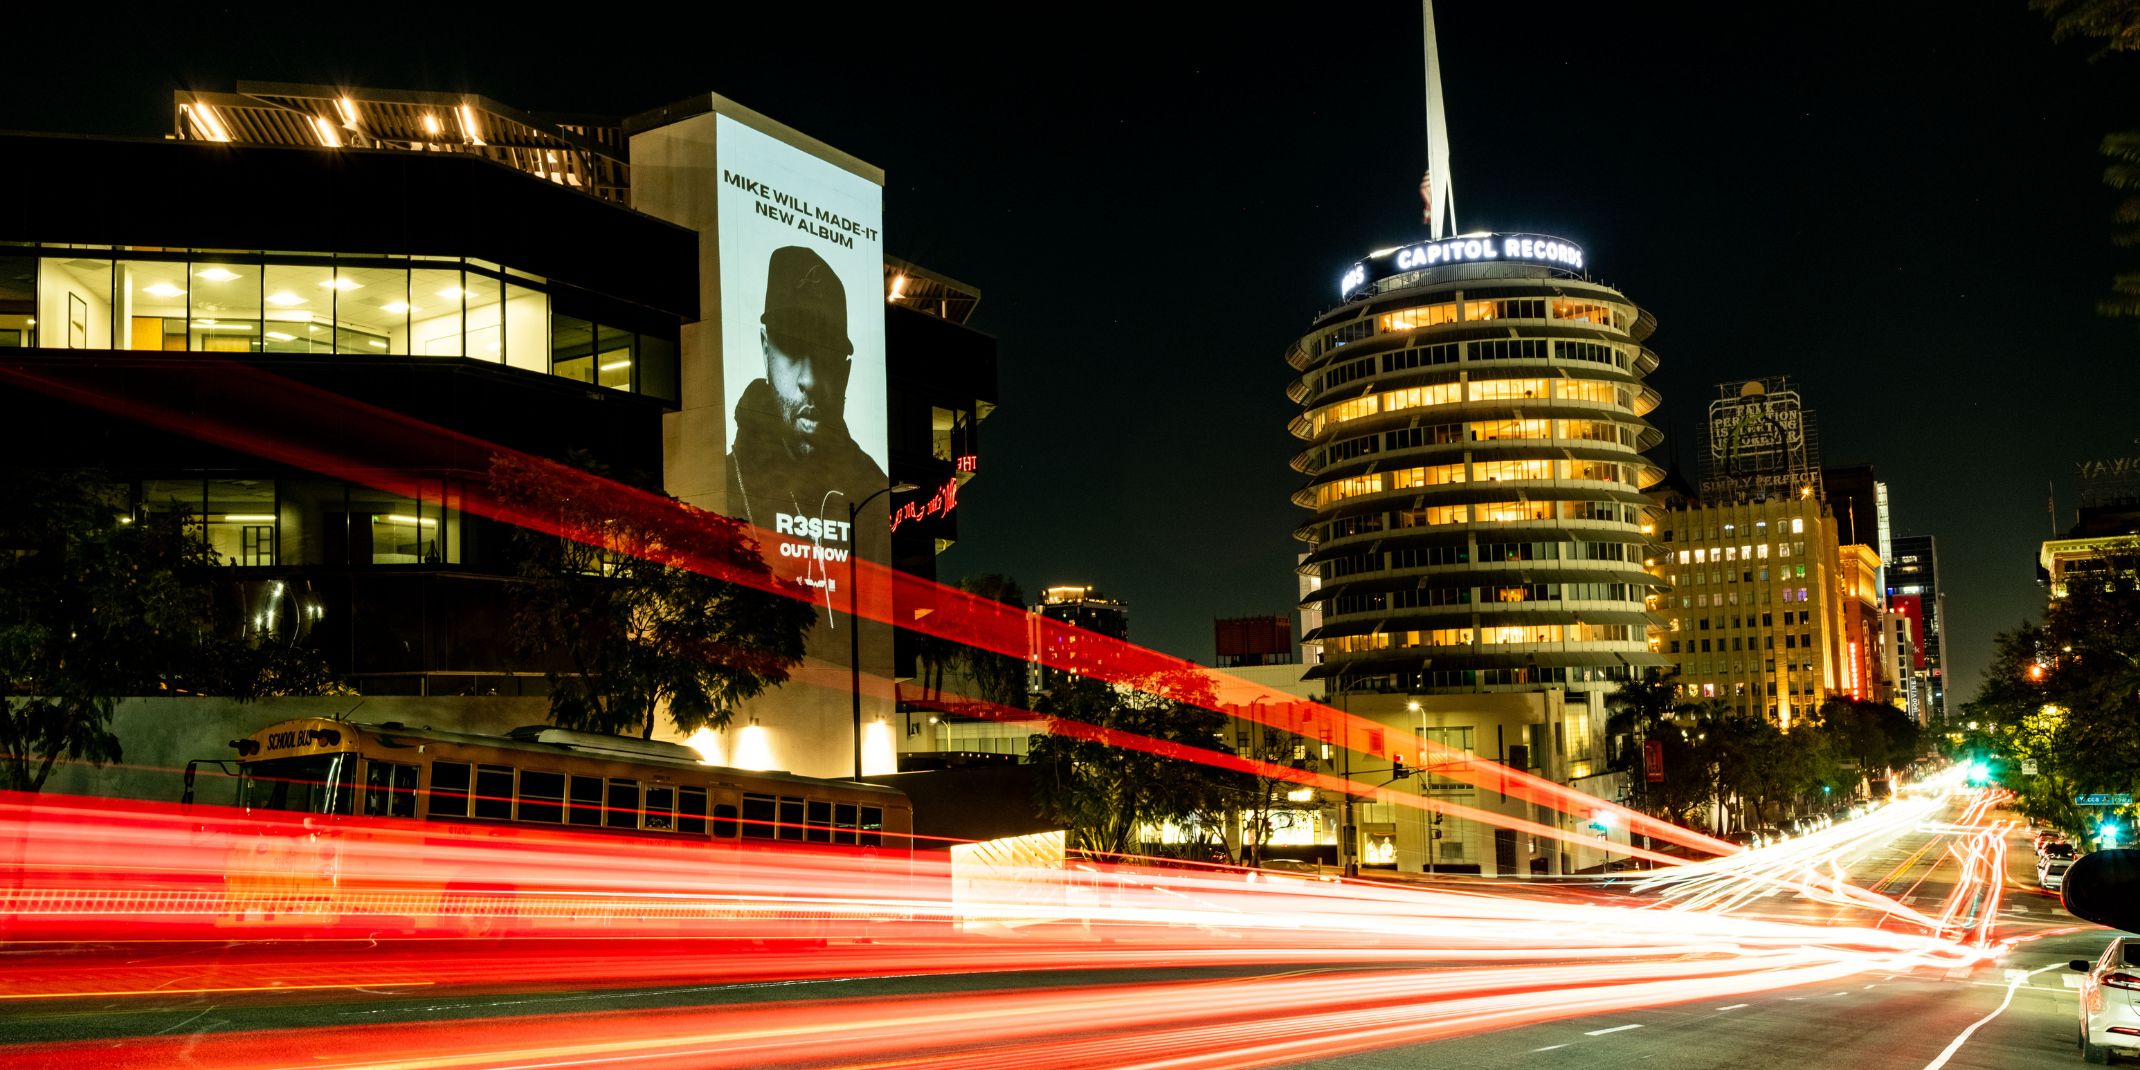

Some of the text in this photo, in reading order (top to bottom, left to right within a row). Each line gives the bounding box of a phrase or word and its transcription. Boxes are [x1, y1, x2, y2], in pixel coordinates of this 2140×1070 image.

[724, 169, 878, 241] MIKE WILL MADE-IT
[755, 201, 853, 249] NEW ALBUM
[1397, 239, 1583, 270] CAPITOL RECORDS
[1755, 471, 1818, 486] PERFECT
[776, 512, 851, 542] R3SET
[780, 542, 848, 562] OUT NOW
[267, 730, 312, 750] SCHOOL BUS
